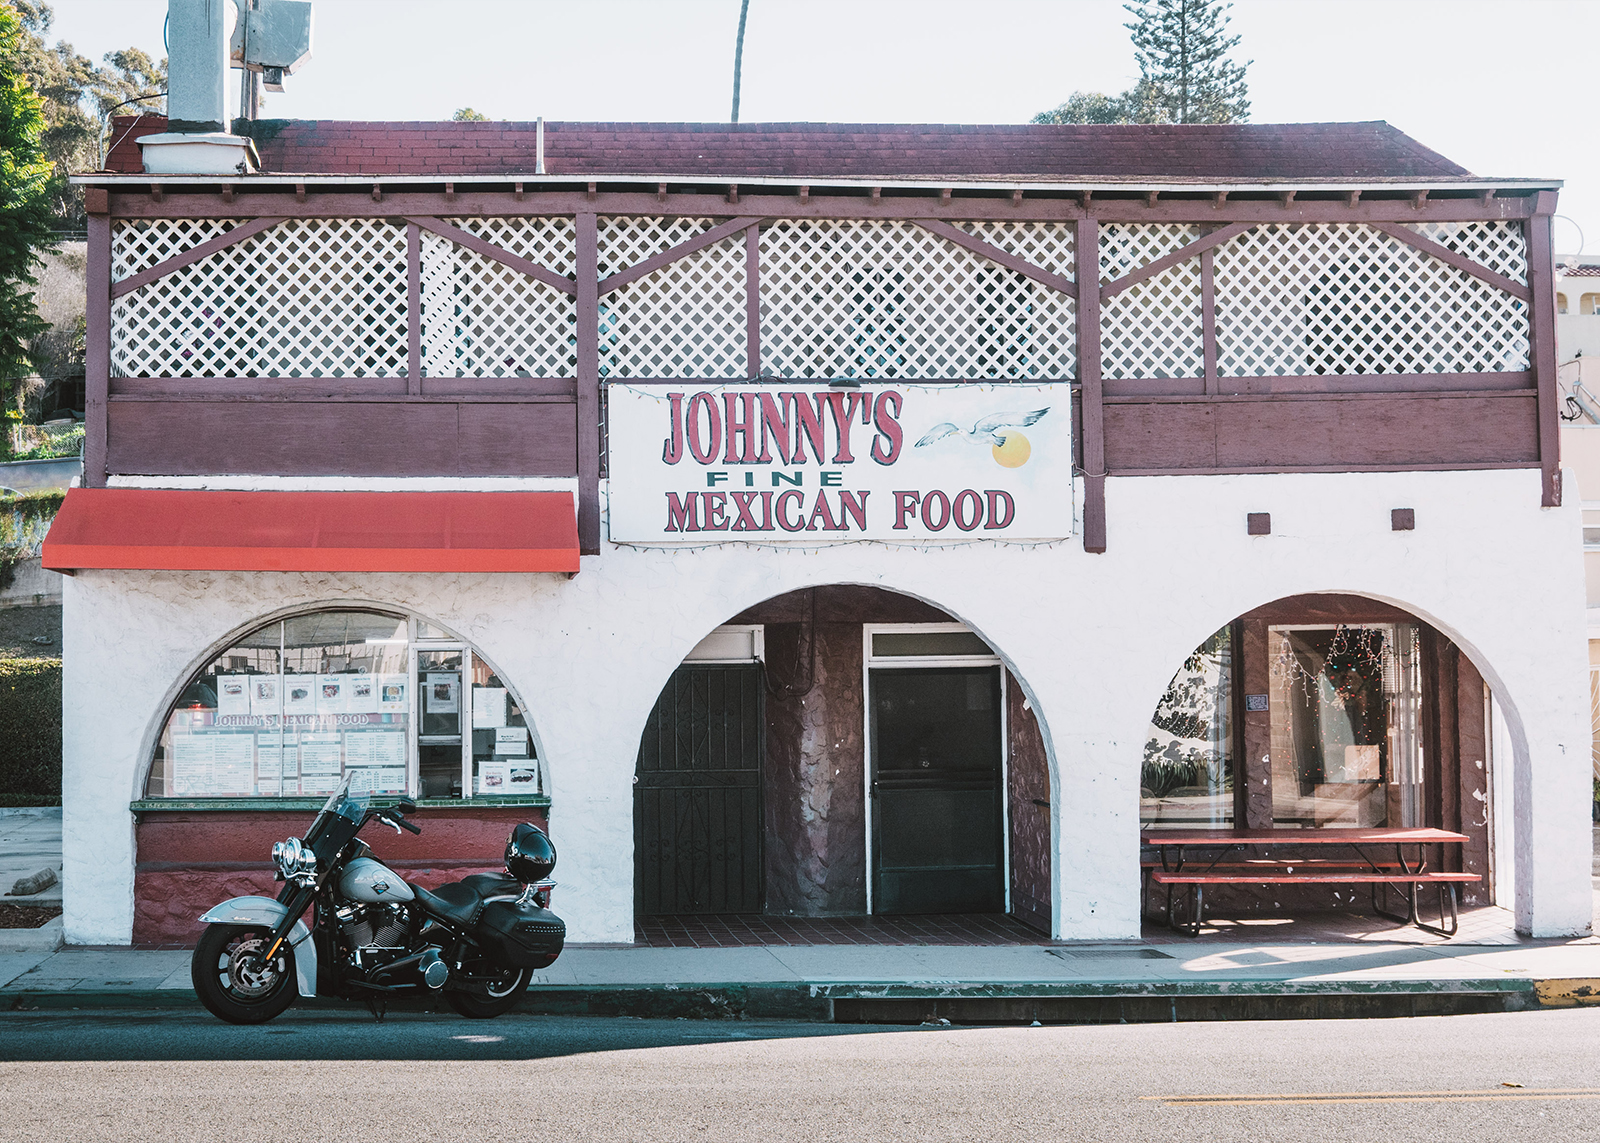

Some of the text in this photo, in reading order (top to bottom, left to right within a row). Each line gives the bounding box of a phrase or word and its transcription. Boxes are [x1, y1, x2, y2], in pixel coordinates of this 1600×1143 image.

[662, 390, 904, 466] JOHNNY'S
[706, 471, 843, 487] FINE
[664, 489, 1016, 532] MEXICAN FOOD
[215, 715, 273, 726] JOHNNYS
[335, 713, 368, 725] FOOD
